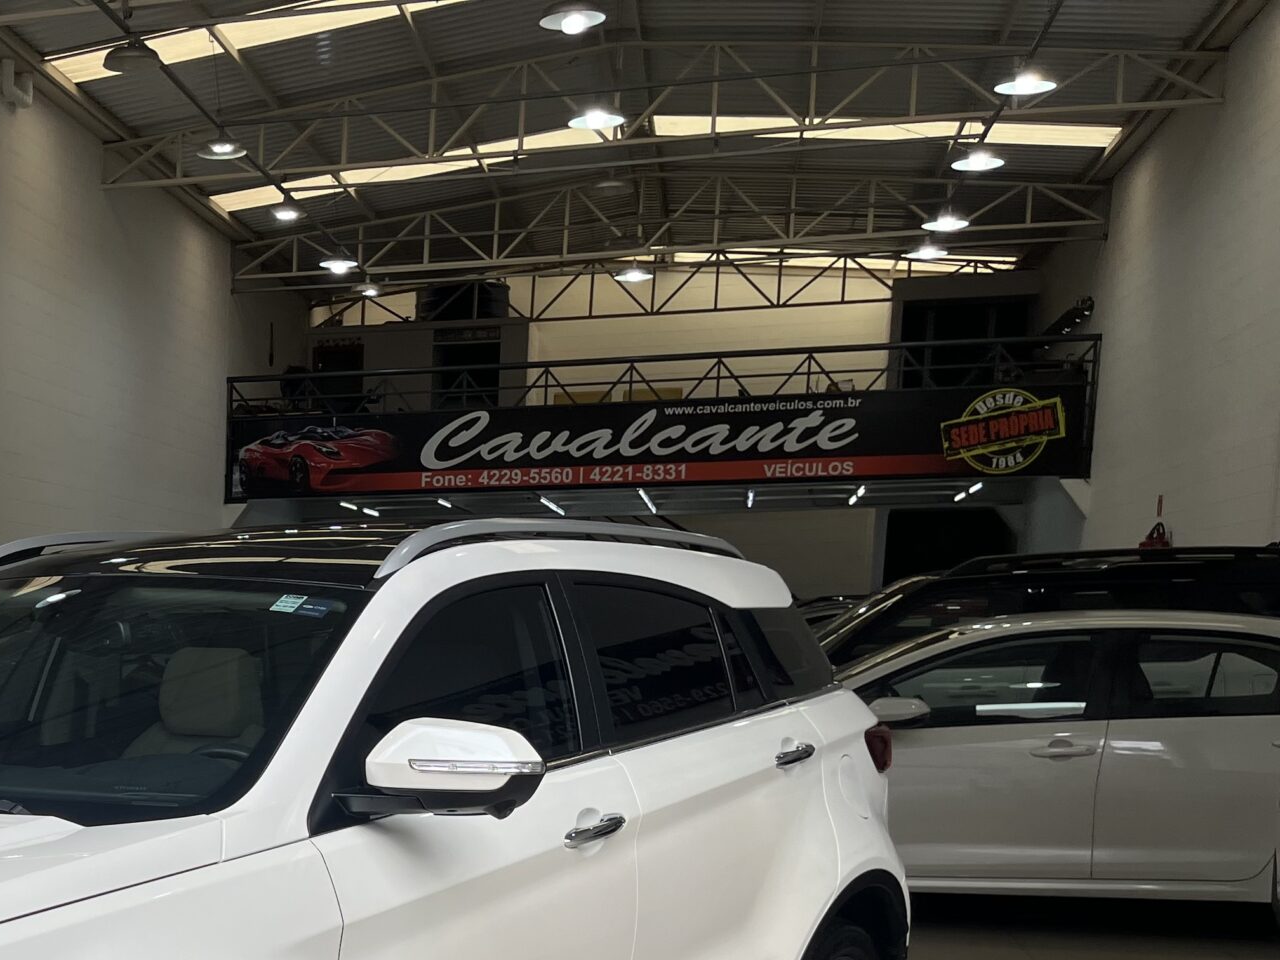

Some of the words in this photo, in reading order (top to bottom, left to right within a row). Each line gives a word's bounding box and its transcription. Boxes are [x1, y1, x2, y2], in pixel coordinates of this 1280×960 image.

[664, 397, 862, 416] www.cavalcanteveiculos.com.br
[975, 392, 1024, 414] Desde
[420, 408, 861, 470] Cavalcante
[950, 421, 986, 449] SEDE
[988, 408, 1056, 440] PRÓPRIA
[763, 460, 855, 478] VEÍCULOS
[991, 452, 1024, 469] 1984
[421, 471, 472, 488] Fone:
[478, 467, 573, 486] 4229-5560
[589, 463, 687, 482] 4221-8331
